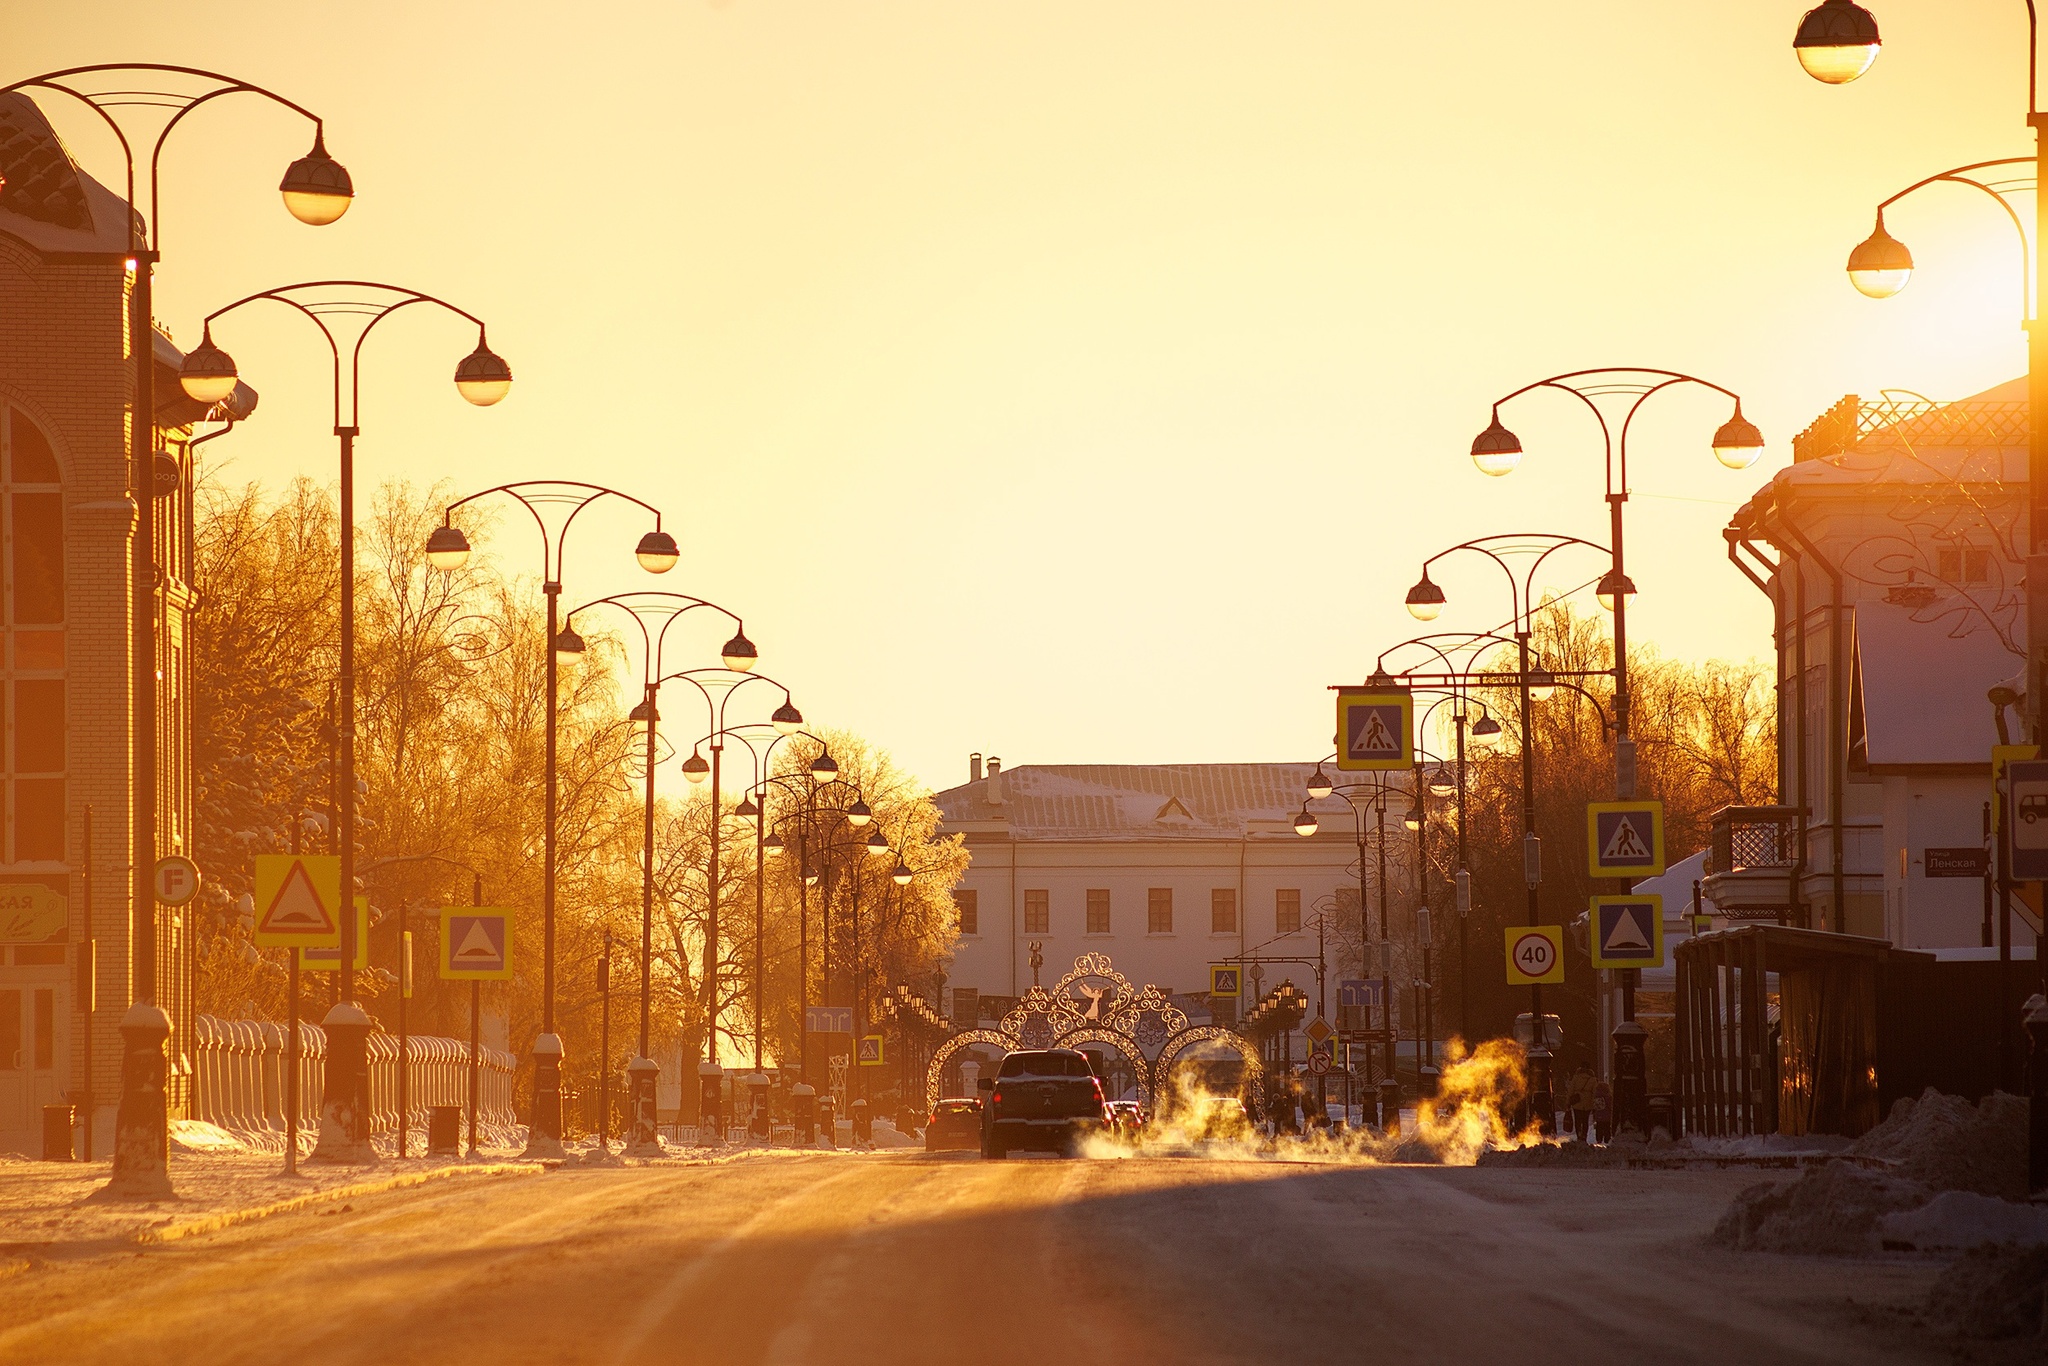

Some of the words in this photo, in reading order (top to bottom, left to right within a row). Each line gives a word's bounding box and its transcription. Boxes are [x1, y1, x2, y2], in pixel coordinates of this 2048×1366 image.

[155, 473, 177, 482] OOD
[1929, 858, 1976, 868] Ленская
[164, 869, 183, 895] F
[1522, 946, 1546, 963] 40
